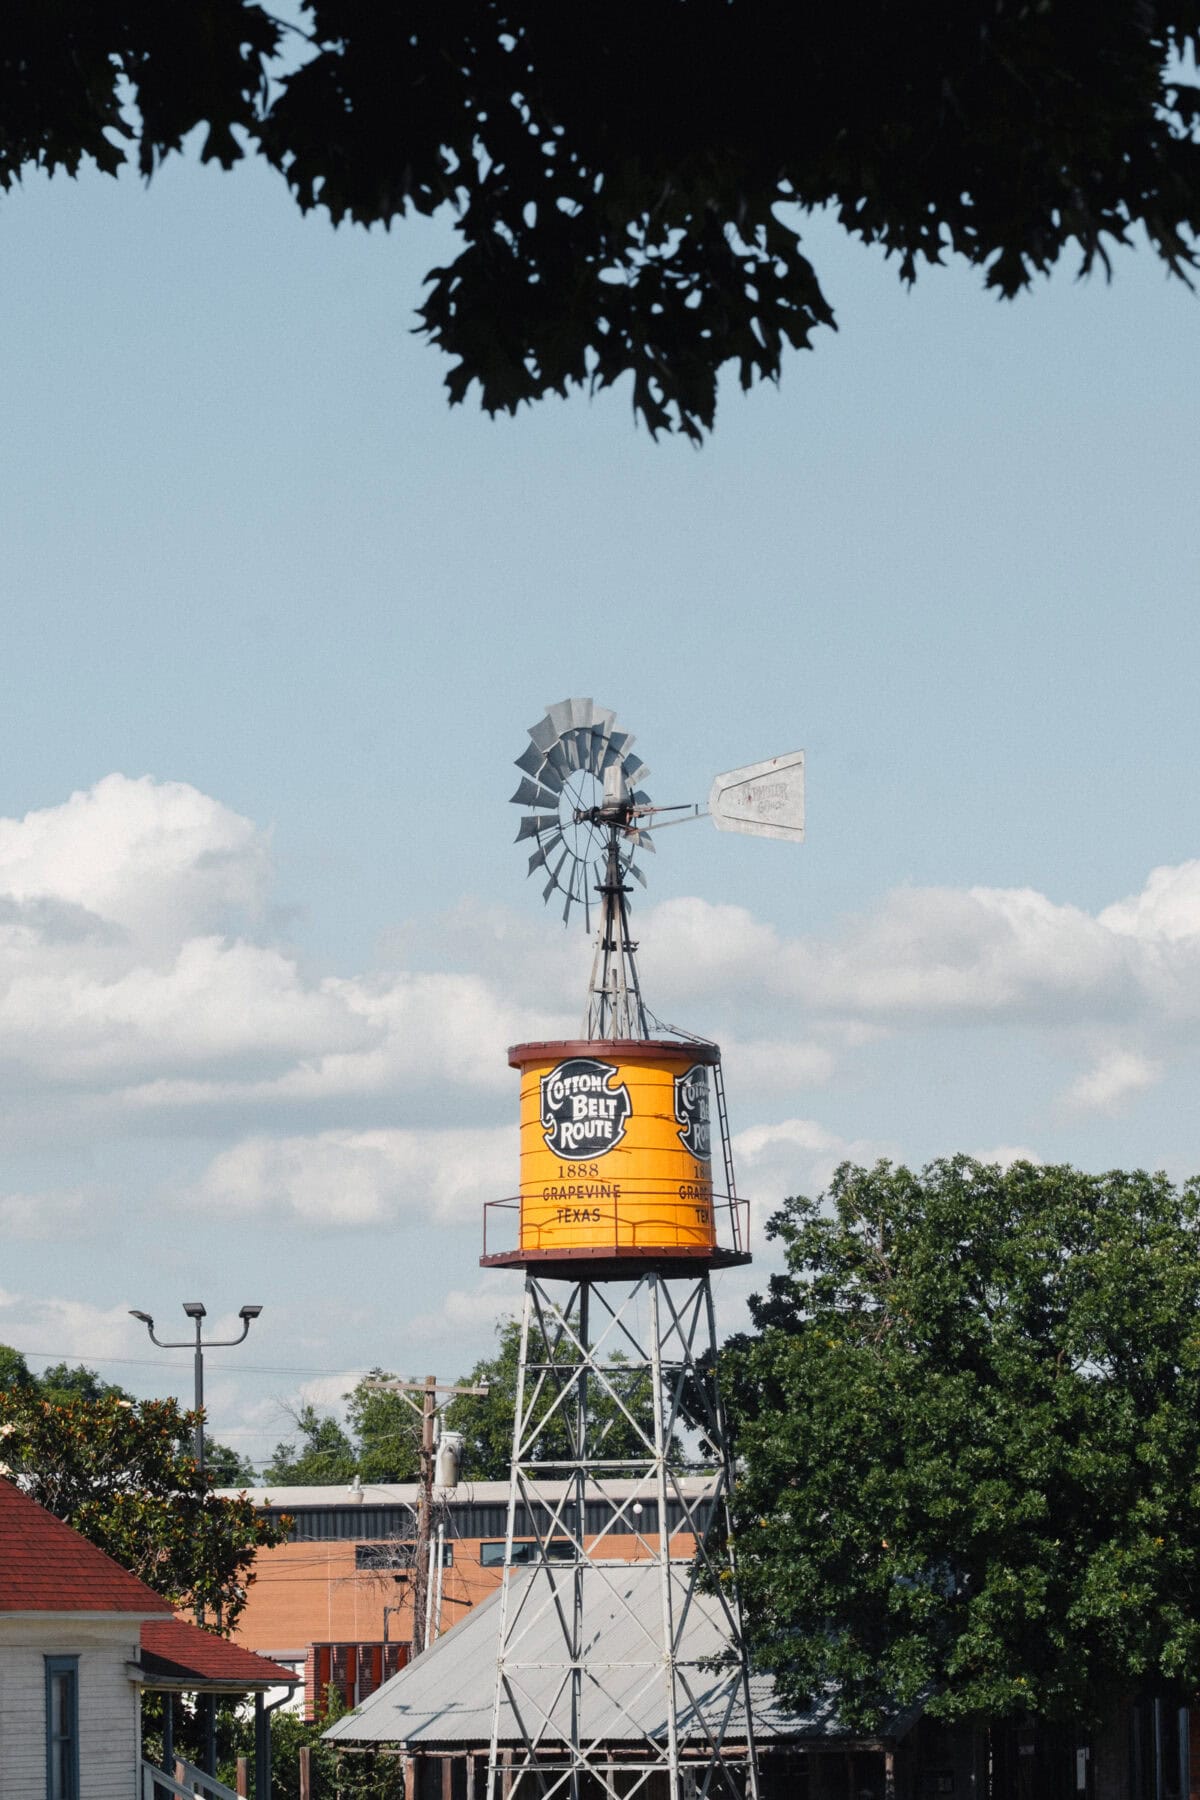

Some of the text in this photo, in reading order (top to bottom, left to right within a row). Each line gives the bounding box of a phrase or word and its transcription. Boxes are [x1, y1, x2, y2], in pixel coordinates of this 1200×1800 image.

[547, 1072, 602, 1110] COTTON
[569, 1095, 617, 1121] BELT
[560, 1120, 612, 1149] ROUTE
[558, 1163, 599, 1178] 1888
[543, 1184, 621, 1201] GRAPEVINE
[557, 1208, 601, 1223] TEXAS
